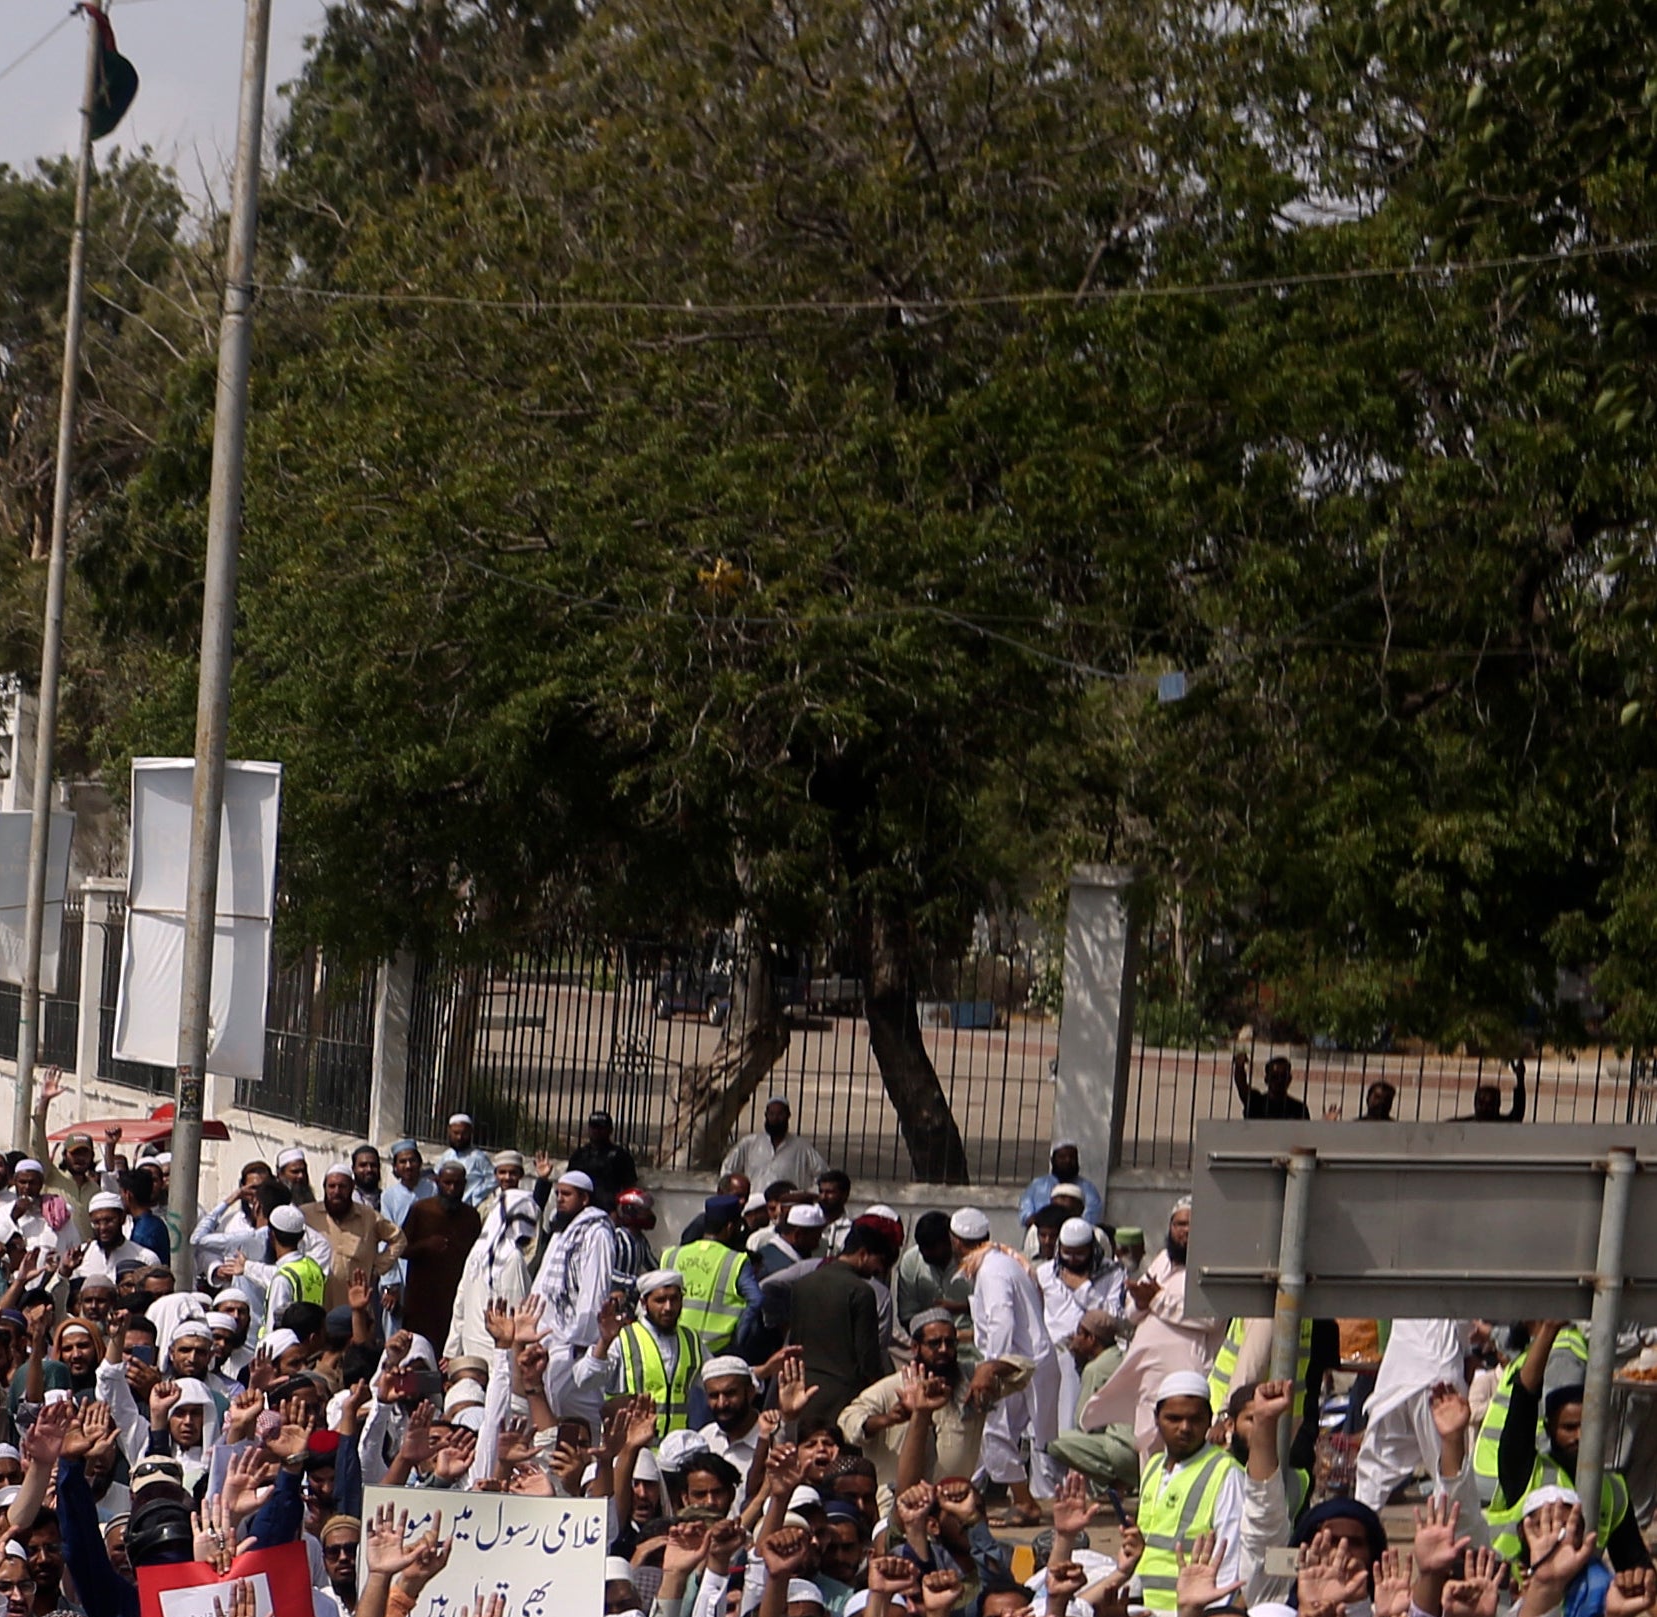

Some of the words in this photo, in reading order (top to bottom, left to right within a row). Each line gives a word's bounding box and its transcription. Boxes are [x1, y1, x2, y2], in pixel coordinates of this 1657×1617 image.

[403, 1512, 432, 1540] مو
[476, 1501, 540, 1551] رسول
[542, 1511, 602, 1554] غلامی
